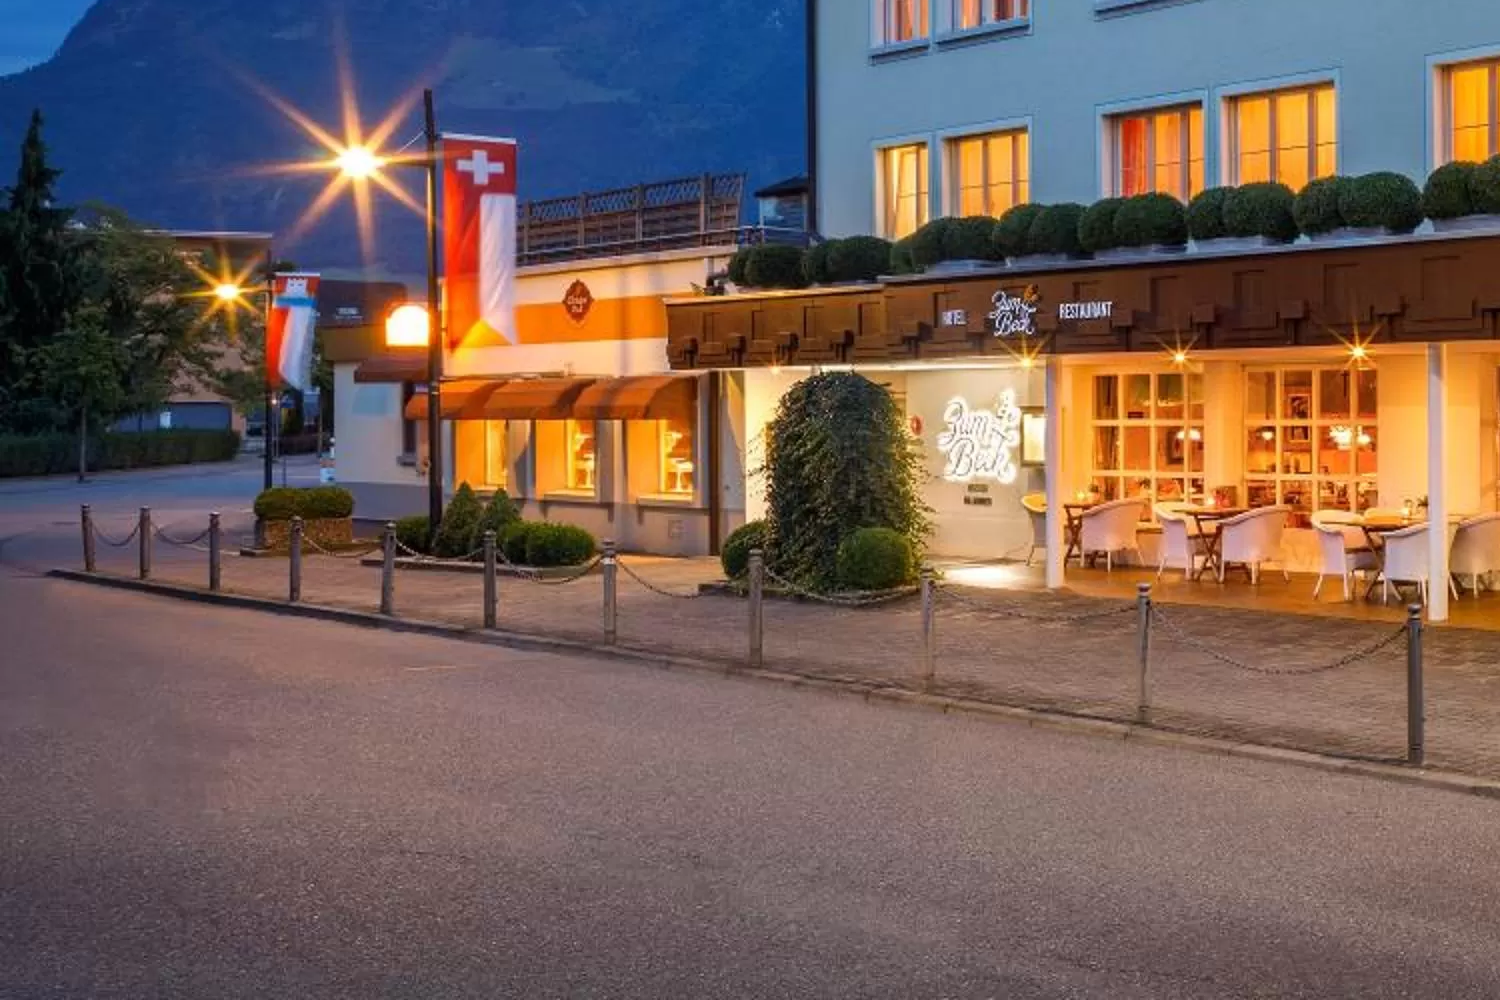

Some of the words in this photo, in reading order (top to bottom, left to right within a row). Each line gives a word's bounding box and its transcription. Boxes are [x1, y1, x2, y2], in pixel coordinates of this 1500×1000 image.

[1059, 301, 1113, 321] RESTAURANT
[938, 397, 1010, 448] Zum
[945, 436, 1015, 481] Beck
